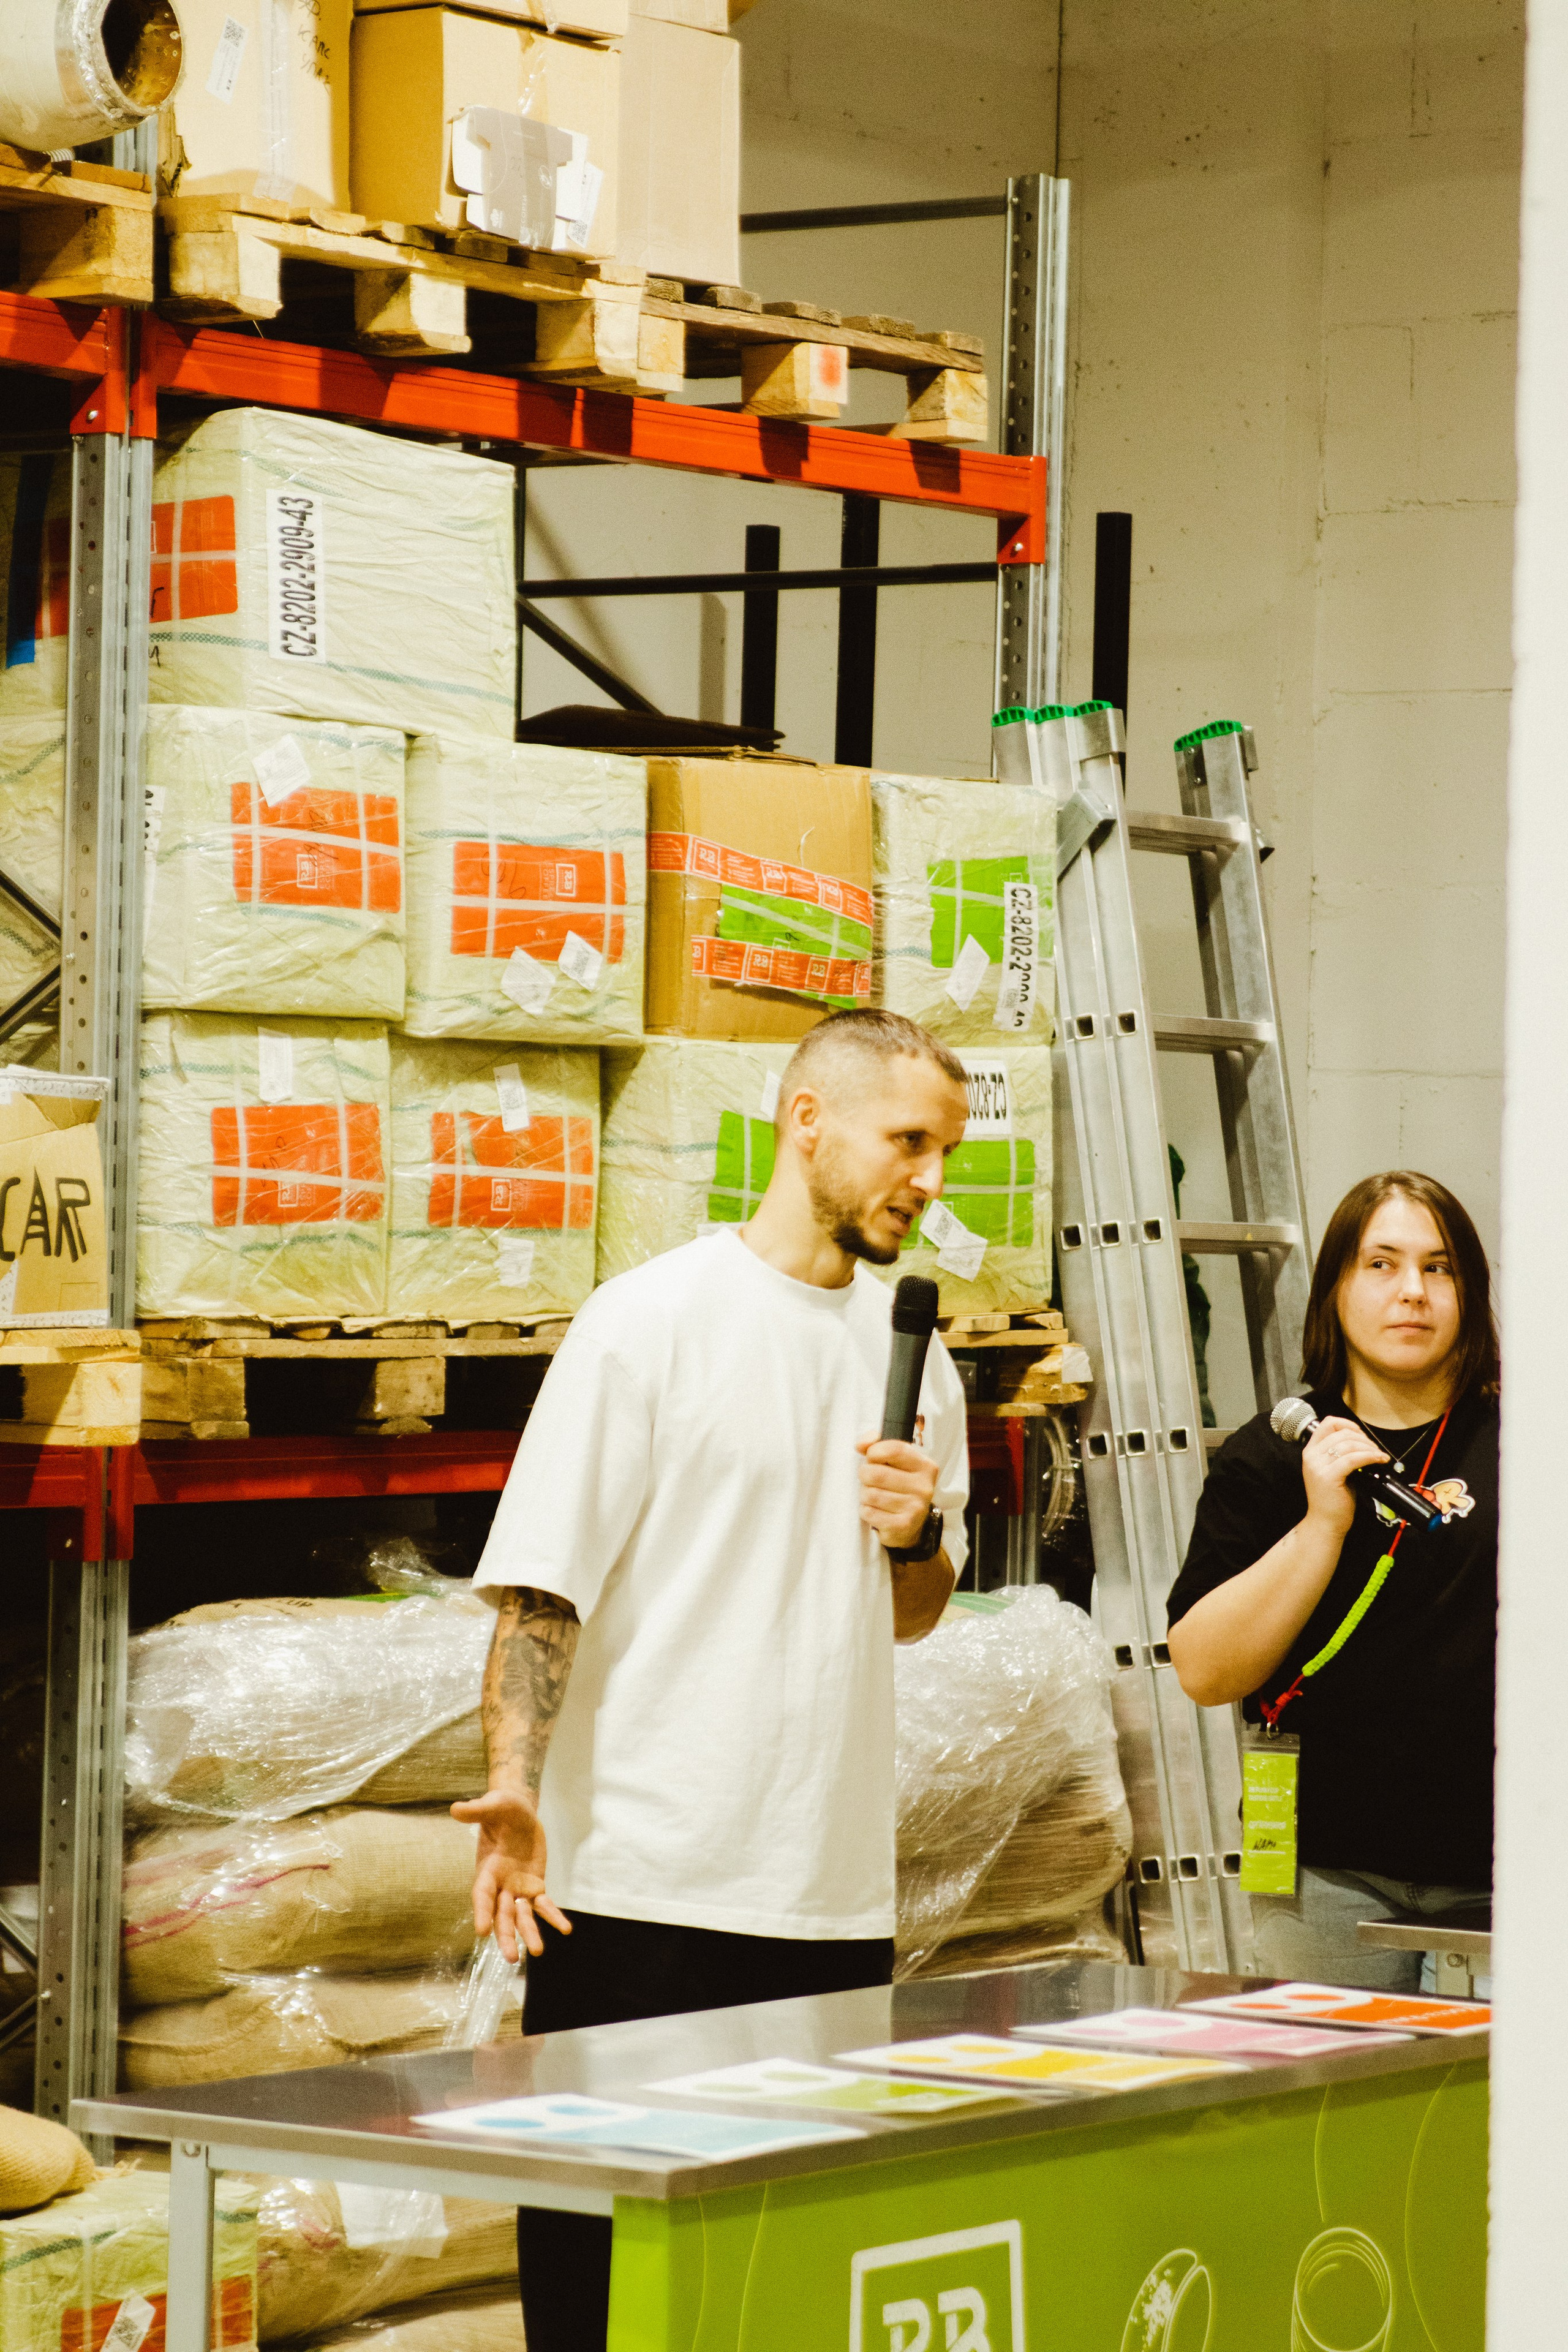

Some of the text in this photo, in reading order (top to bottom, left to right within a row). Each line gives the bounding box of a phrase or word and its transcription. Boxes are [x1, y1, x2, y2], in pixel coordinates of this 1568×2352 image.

[277, 495, 317, 657] CZ-8202-2909-43
[1008, 887, 1032, 1027] CZ-8202-2
[968, 1072, 1007, 1120] CZ-820
[0, 1166, 91, 1263] CAR
